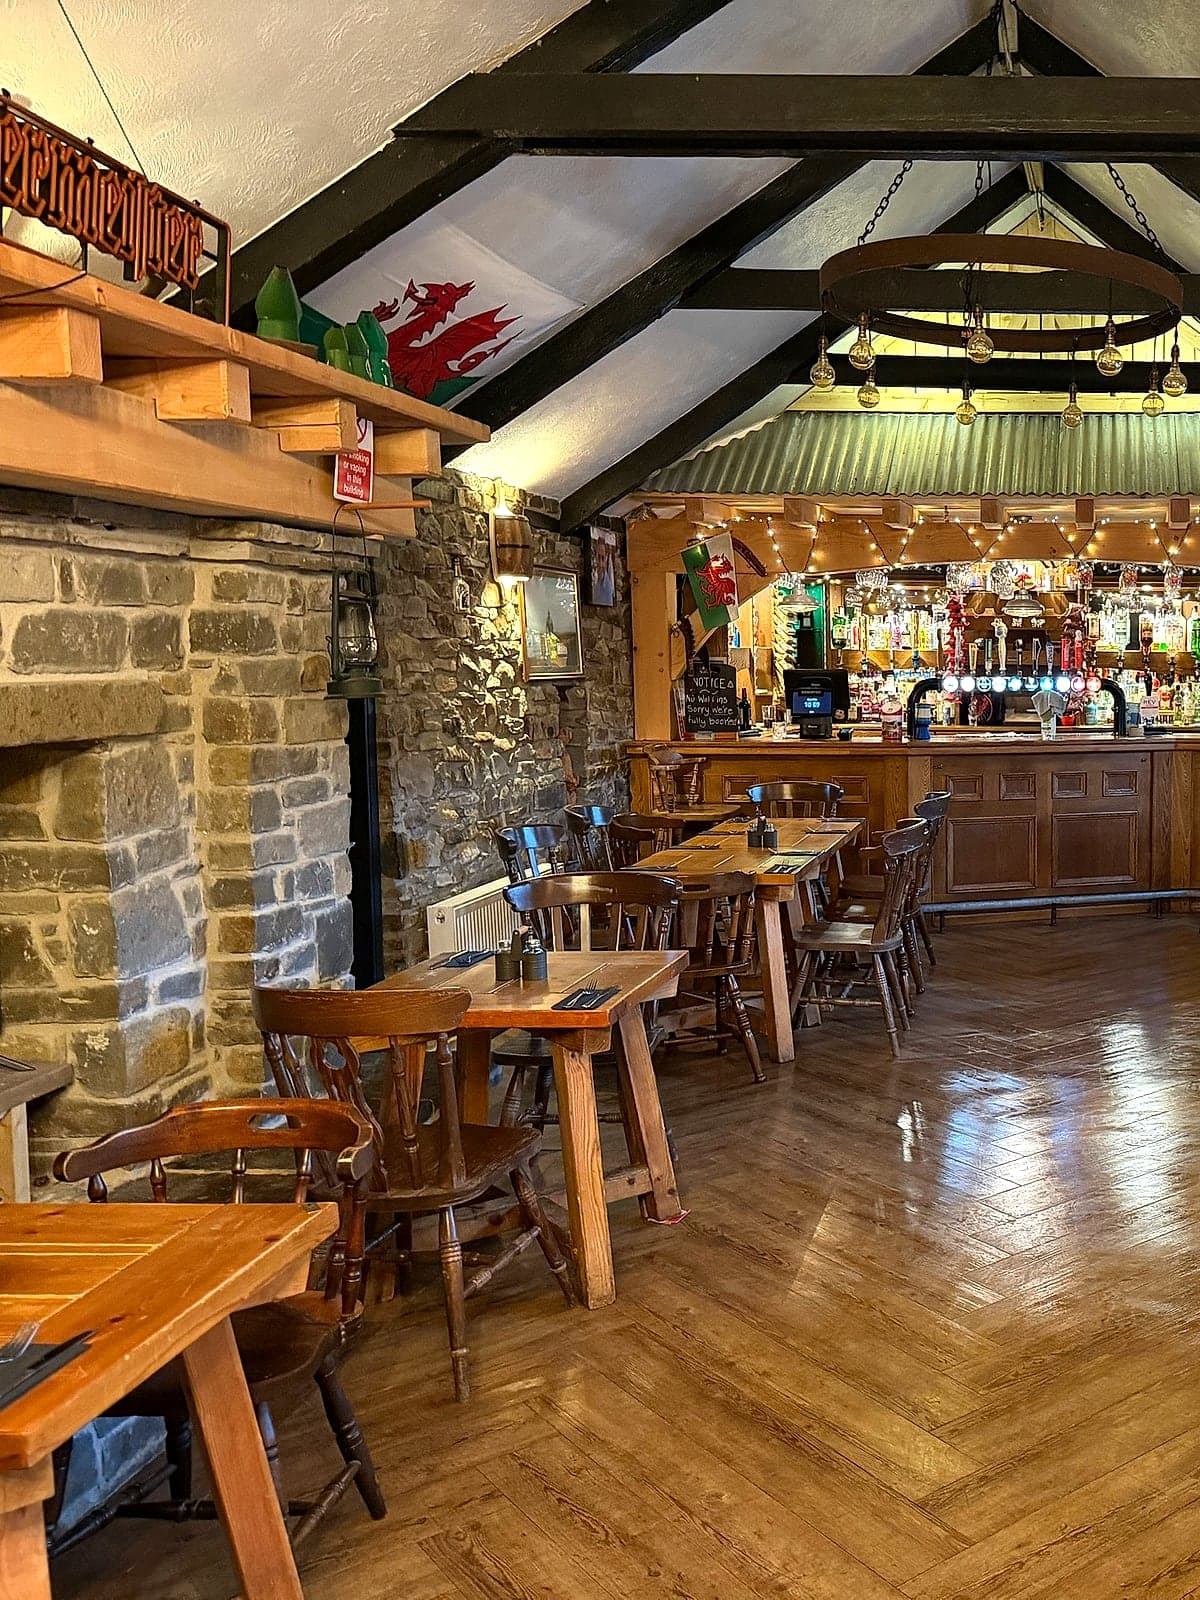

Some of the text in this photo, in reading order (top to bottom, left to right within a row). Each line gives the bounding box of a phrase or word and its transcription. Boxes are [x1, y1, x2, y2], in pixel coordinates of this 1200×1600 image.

[350, 463, 367, 476] vaping
[352, 474, 362, 484] this
[343, 483, 364, 498] building
[693, 677, 727, 689] NOTICE
[687, 704, 710, 716] Sorry
[688, 714, 706, 728] fully
